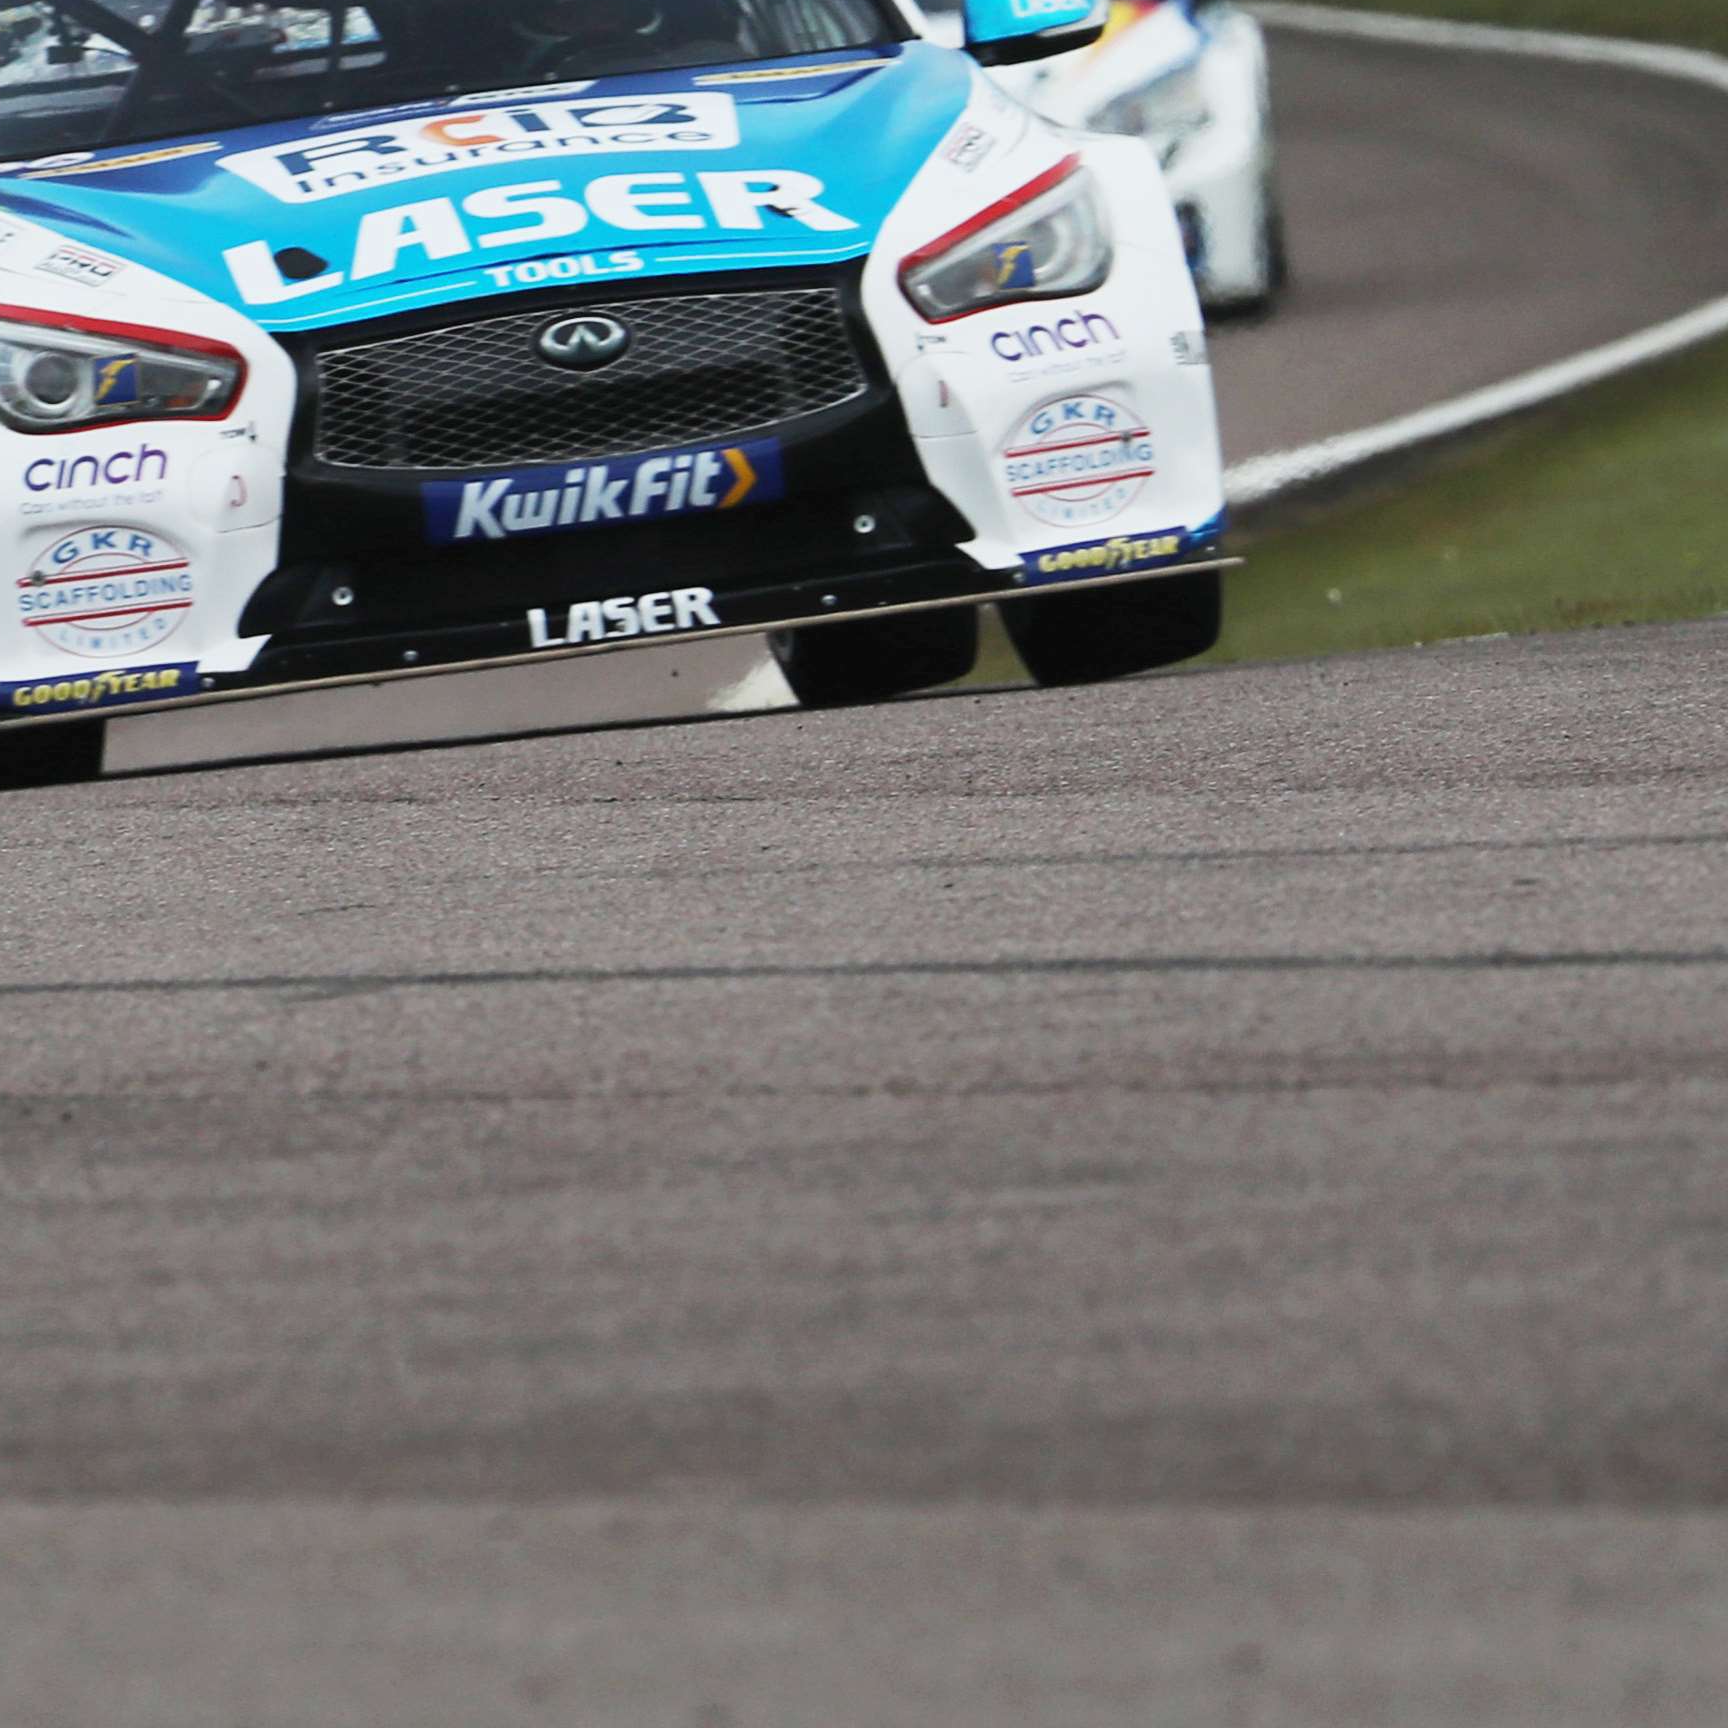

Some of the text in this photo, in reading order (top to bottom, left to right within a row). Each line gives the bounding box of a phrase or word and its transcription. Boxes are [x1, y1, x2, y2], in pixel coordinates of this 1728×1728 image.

[222, 170, 860, 306] LASER
[483, 249, 646, 288] TOOLS
[991, 309, 1121, 363] cinch
[1030, 402, 1116, 435] GKR
[24, 443, 168, 492] cinch
[1005, 444, 1154, 482] SCAFFOLDING
[52, 531, 153, 565] GKR
[1039, 535, 1182, 572] GOODYEAR
[18, 573, 194, 612] SCAFFOLDING
[529, 586, 721, 648] LASER
[13, 669, 181, 706] GOODYEAR
